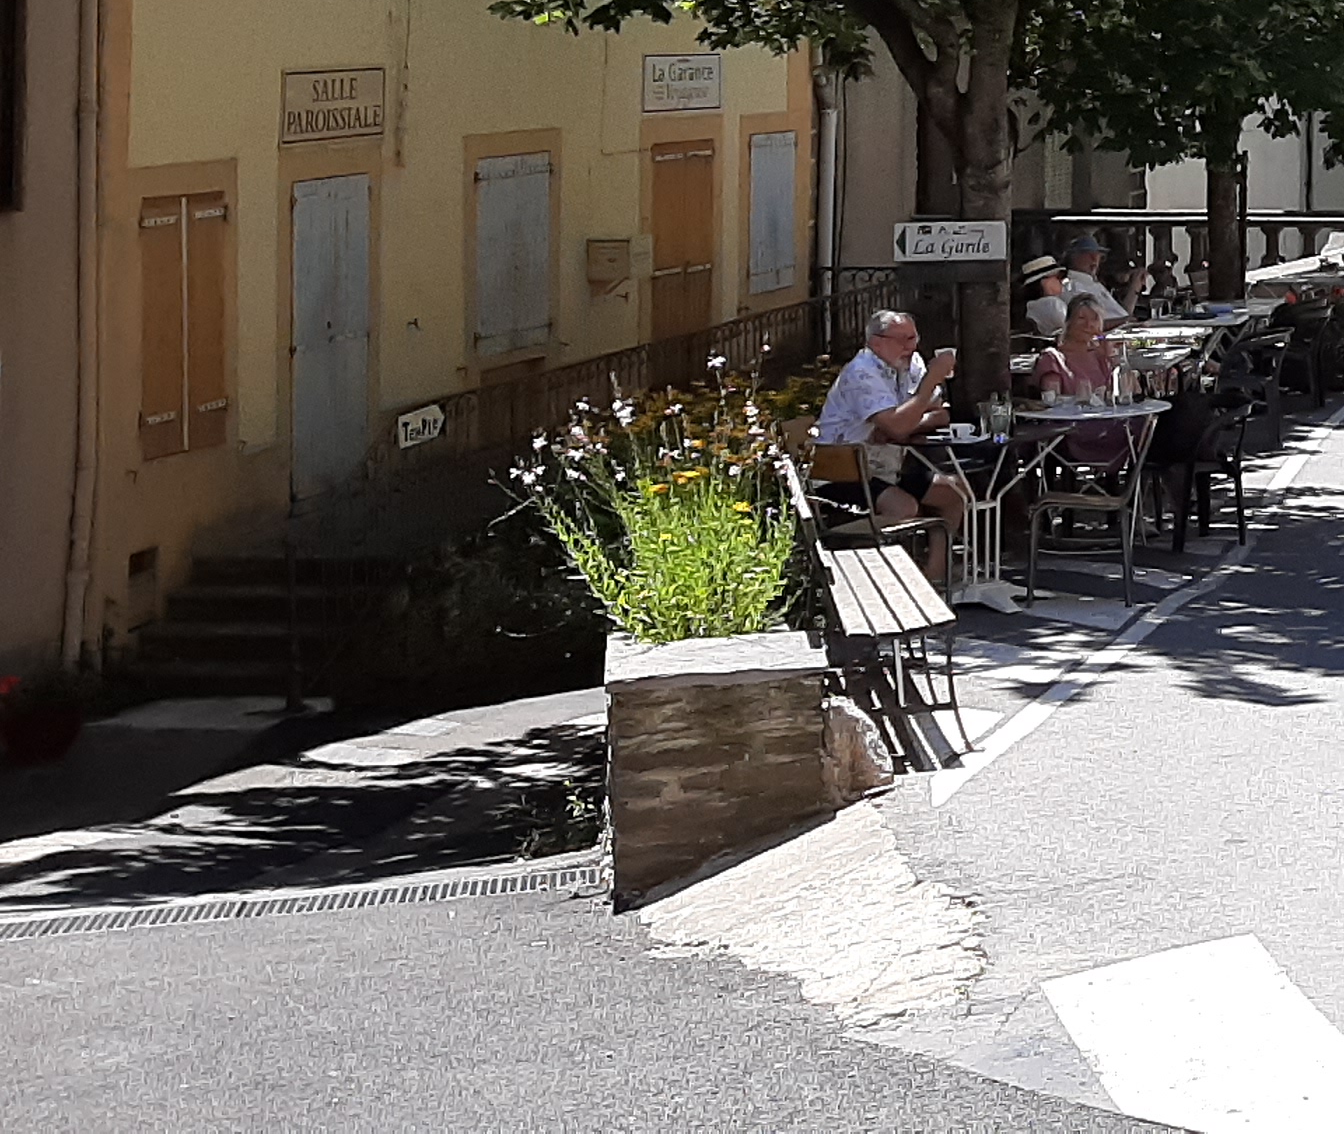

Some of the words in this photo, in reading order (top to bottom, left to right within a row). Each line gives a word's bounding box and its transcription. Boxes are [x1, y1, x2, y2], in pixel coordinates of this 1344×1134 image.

[652, 63, 665, 83] La
[312, 77, 357, 103] SALLE
[287, 105, 381, 134] PAROISSIALE
[912, 239, 935, 255] La
